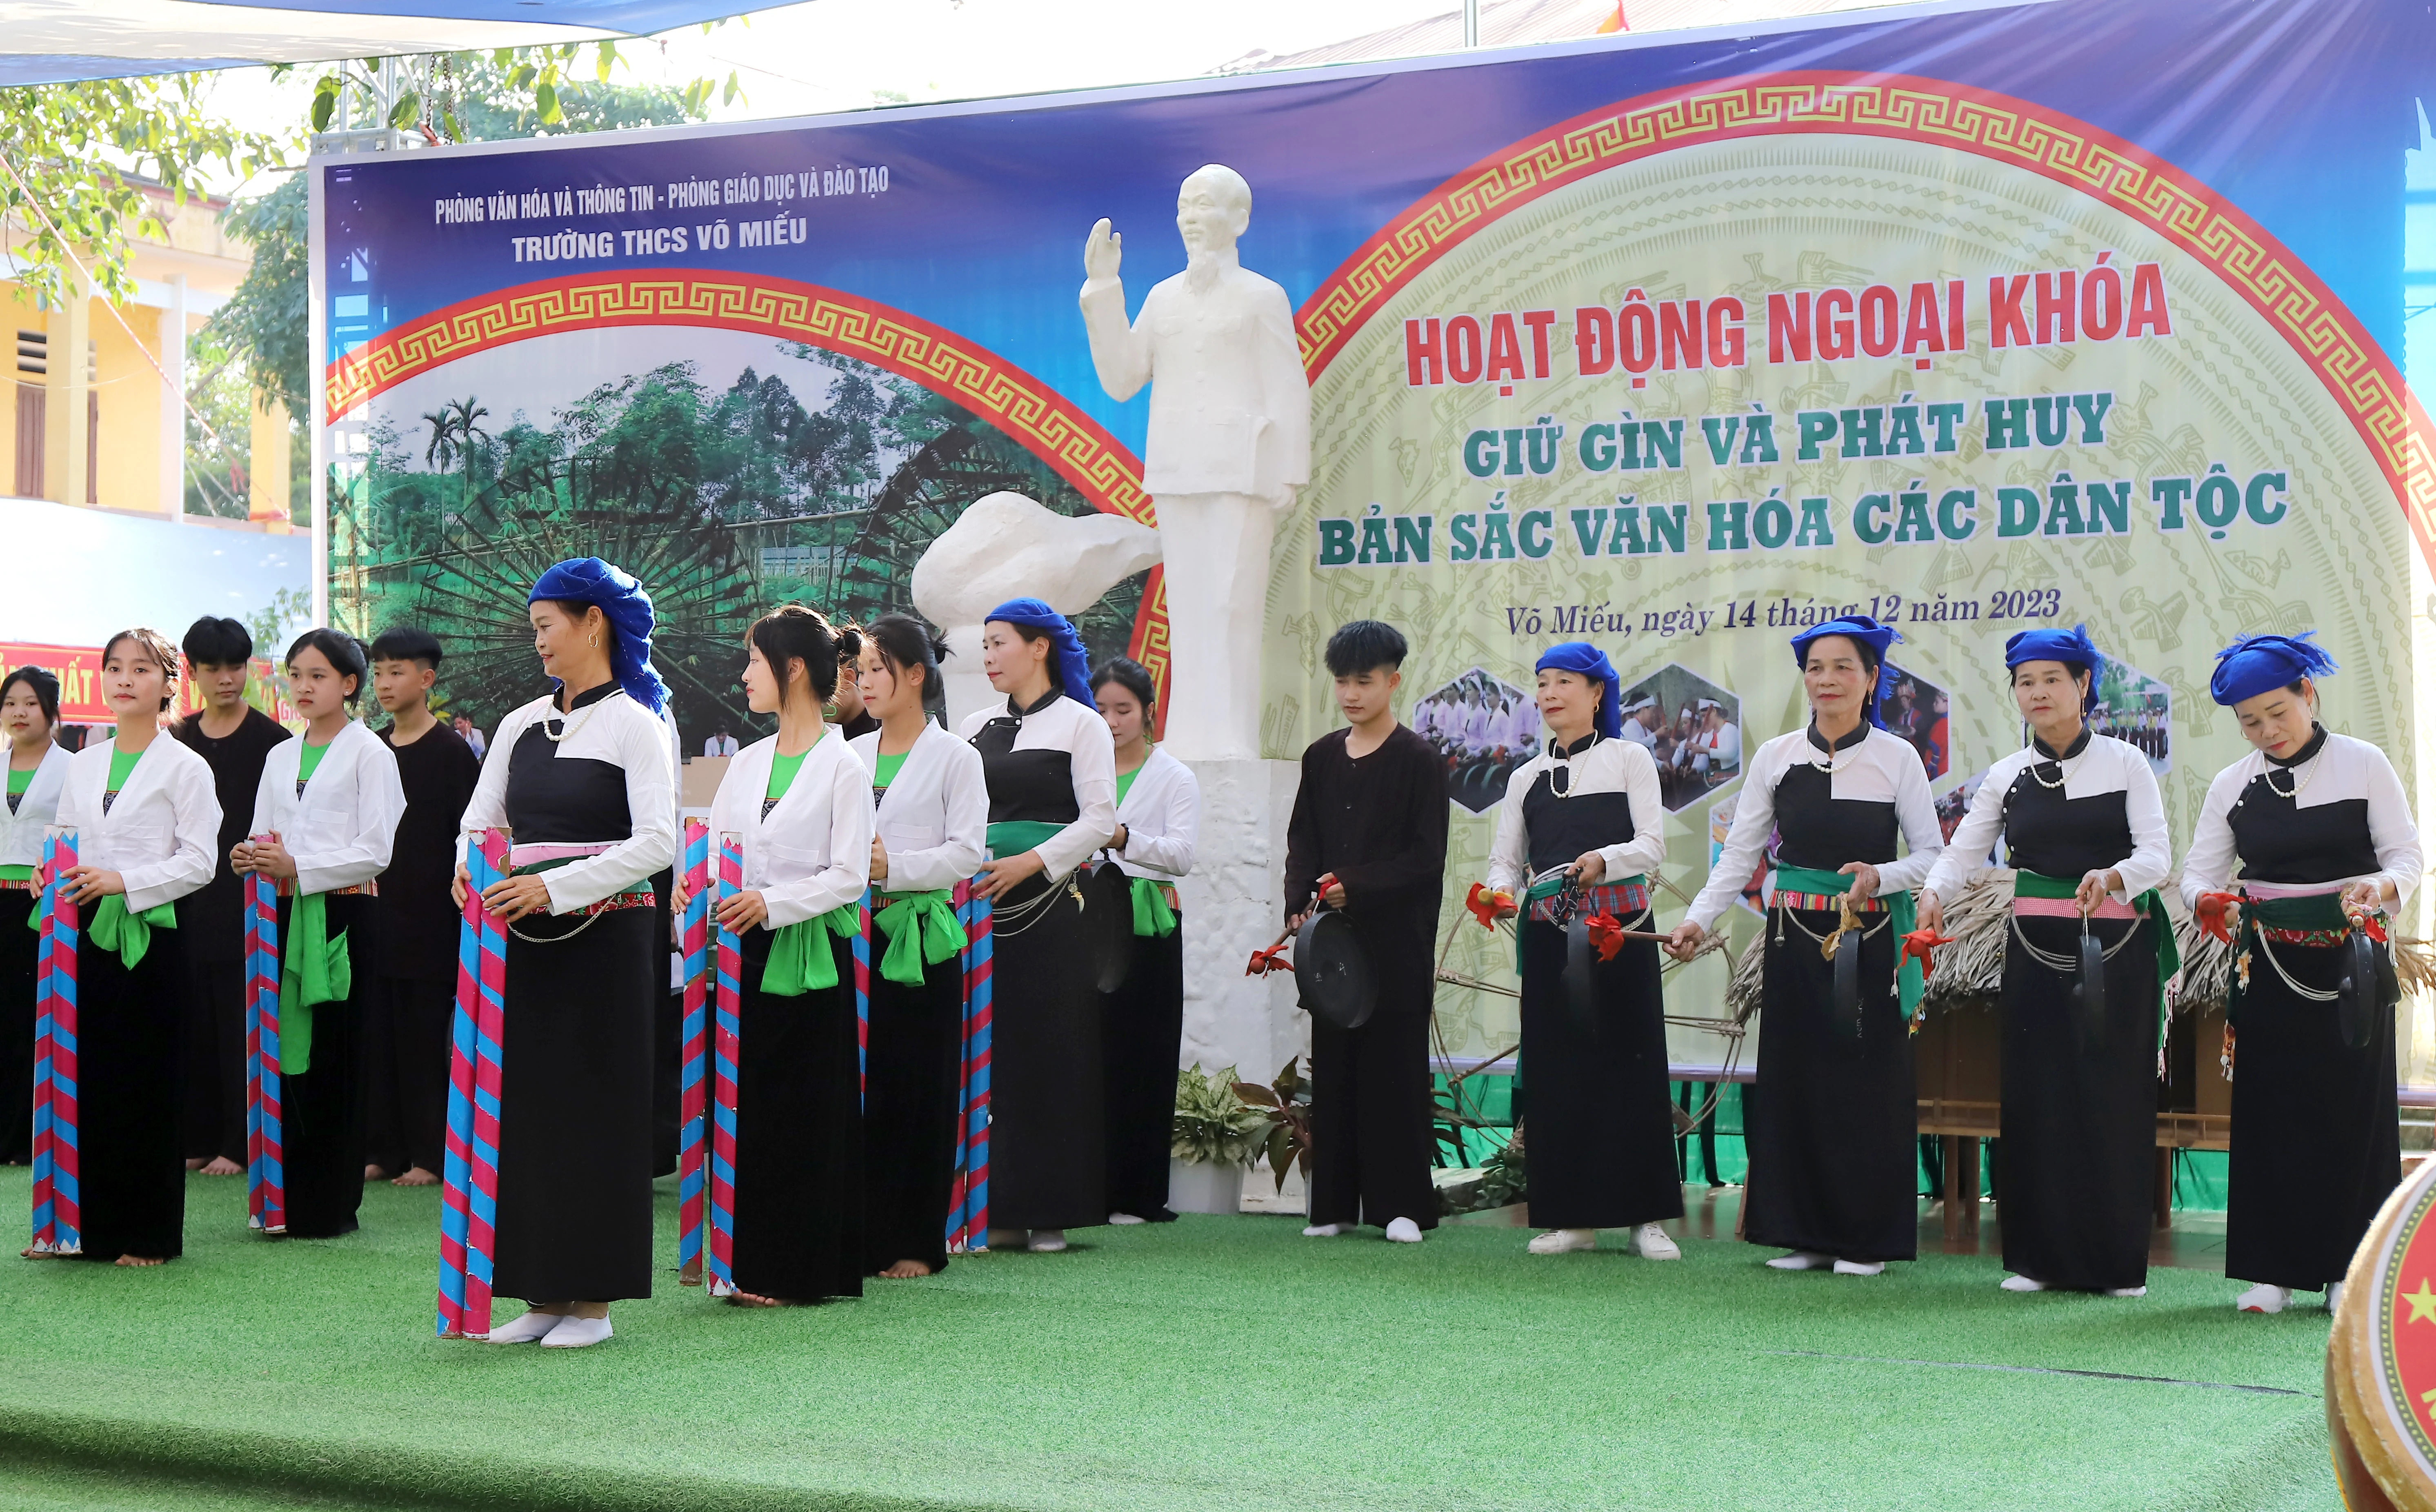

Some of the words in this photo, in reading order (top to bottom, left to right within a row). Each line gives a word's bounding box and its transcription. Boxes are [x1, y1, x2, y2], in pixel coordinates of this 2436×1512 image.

[436, 192, 484, 224] PHÒNG
[487, 190, 516, 220] VĂN
[521, 187, 551, 218] HÓA
[554, 185, 573, 216] VÀ
[576, 183, 625, 215] THÔNG
[629, 185, 653, 211] TIN
[668, 175, 720, 209] PHÒNG
[724, 172, 759, 204] GIÁO
[764, 173, 795, 206] DỤC
[799, 166, 820, 198] VÀ
[823, 164, 855, 196] ĐÀO
[858, 166, 889, 198] TẠO
[511, 228, 613, 262] TRƯỜNG
[621, 227, 688, 256] THCS
[696, 218, 729, 250] VÕ
[739, 209, 807, 248] MIẾU
[1406, 310, 1555, 397] HOẠT
[1575, 289, 1745, 389] ĐỘNG
[1768, 280, 1965, 370] NGOẠI
[1989, 251, 2171, 348] KHÓA
[1464, 416, 1563, 477] GIỮ
[1580, 411, 1683, 471] GÌN
[1703, 403, 1779, 465] VÀ
[1798, 394, 1964, 460] PHÁT
[1985, 393, 2112, 449] HUY
[1320, 505, 1432, 565] BẢN
[1451, 490, 1553, 560] SẮC
[1571, 495, 1687, 556] VĂN
[1707, 488, 1834, 551] HÓA
[1853, 481, 1976, 544] CÁC
[1998, 473, 2131, 537] DÂN
[2153, 463, 2287, 540] TỘC
[1505, 607, 1541, 635] Võ
[1550, 601, 1632, 637] Miếu,
[1642, 602, 1715, 637] ngày
[1724, 600, 1756, 628] 14
[1870, 594, 1902, 623] 12
[1909, 592, 1980, 622] năm
[1988, 588, 2061, 619] 2023
[42, 656, 93, 705] UẤT
